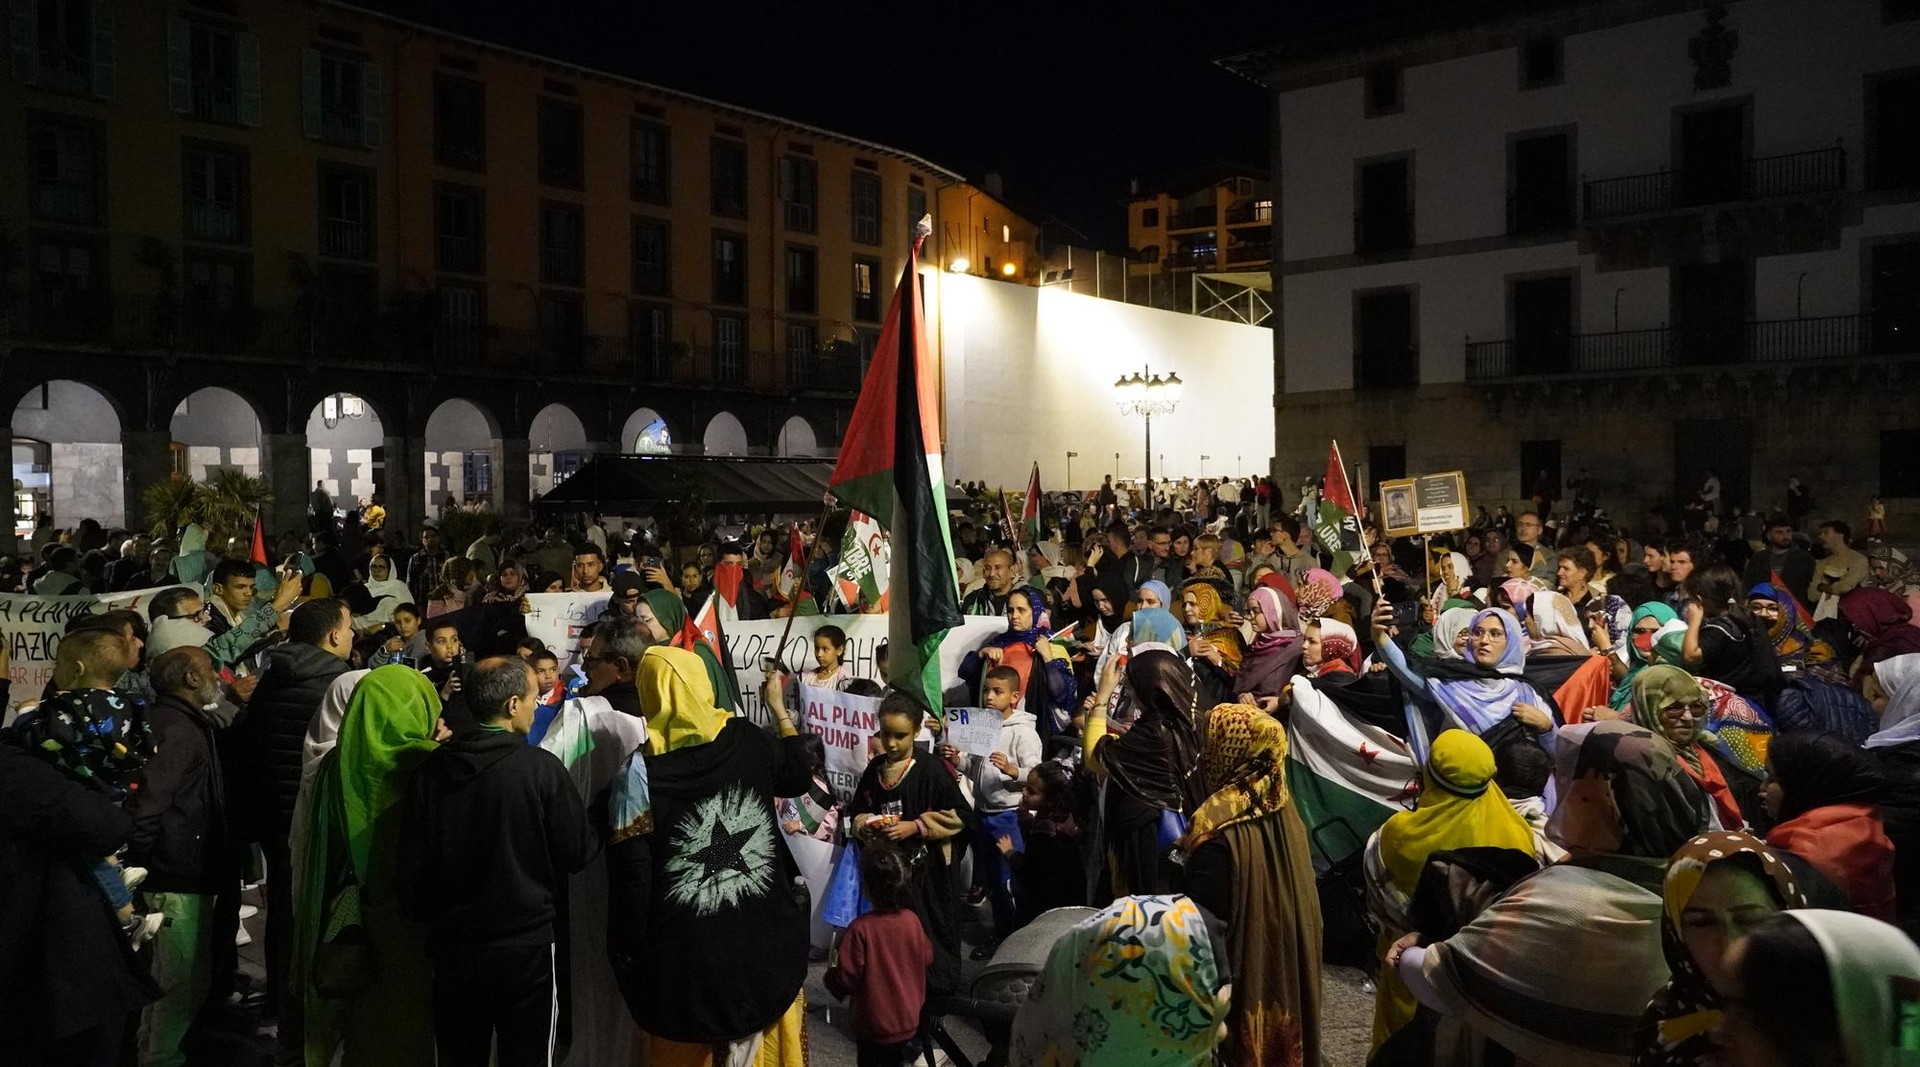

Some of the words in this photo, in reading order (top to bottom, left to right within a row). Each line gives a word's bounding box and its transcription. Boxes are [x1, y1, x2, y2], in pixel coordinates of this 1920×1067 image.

[1317, 525, 1342, 553] URE
[807, 701, 828, 722] AL
[832, 705, 876, 731] PLAN
[806, 722, 860, 750] TRUMP
